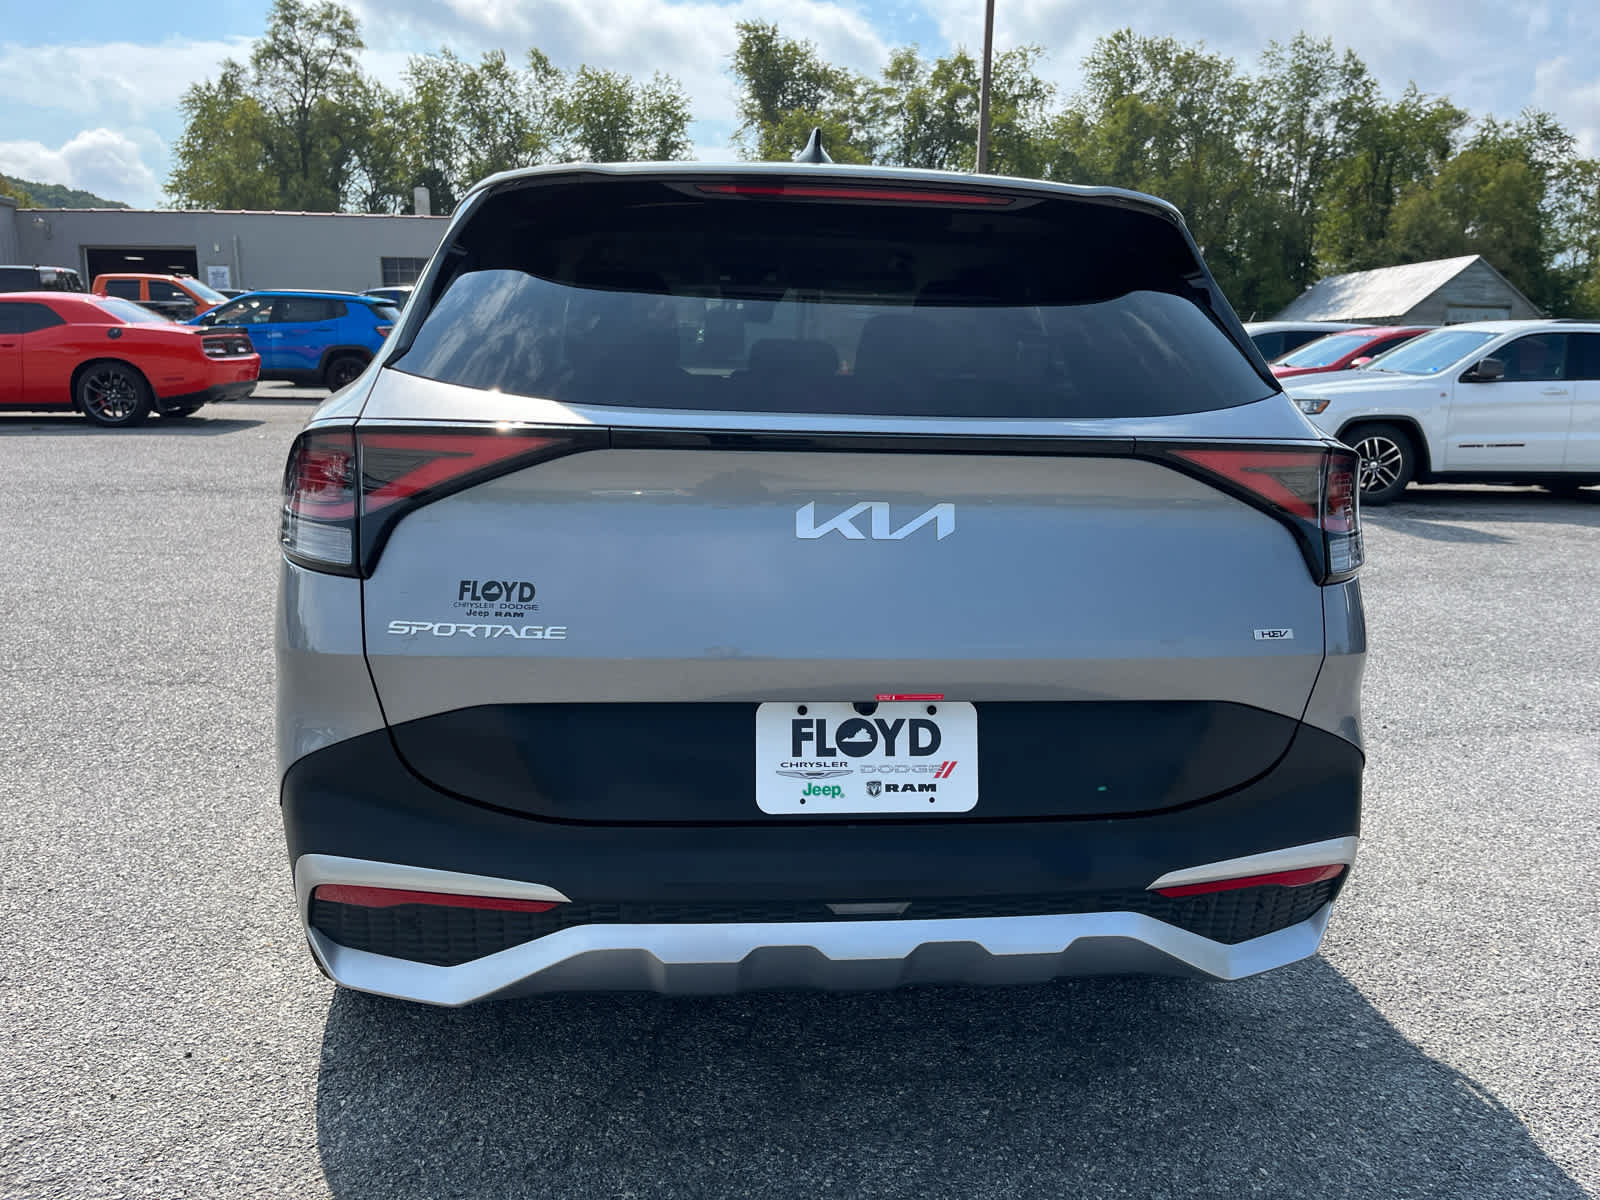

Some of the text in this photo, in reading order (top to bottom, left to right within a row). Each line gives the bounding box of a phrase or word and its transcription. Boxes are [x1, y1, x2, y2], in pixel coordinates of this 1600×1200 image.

[796, 501, 956, 541] KIA
[458, 580, 536, 602] FLOYD
[466, 609, 489, 618] Jeep
[500, 603, 540, 611] DODGE
[387, 620, 568, 640] SPORTAGE
[1261, 630, 1289, 638] HEV
[791, 717, 942, 758] FLOYD
[860, 764, 943, 774] DODGE
[802, 782, 937, 798] Jeep RAM
